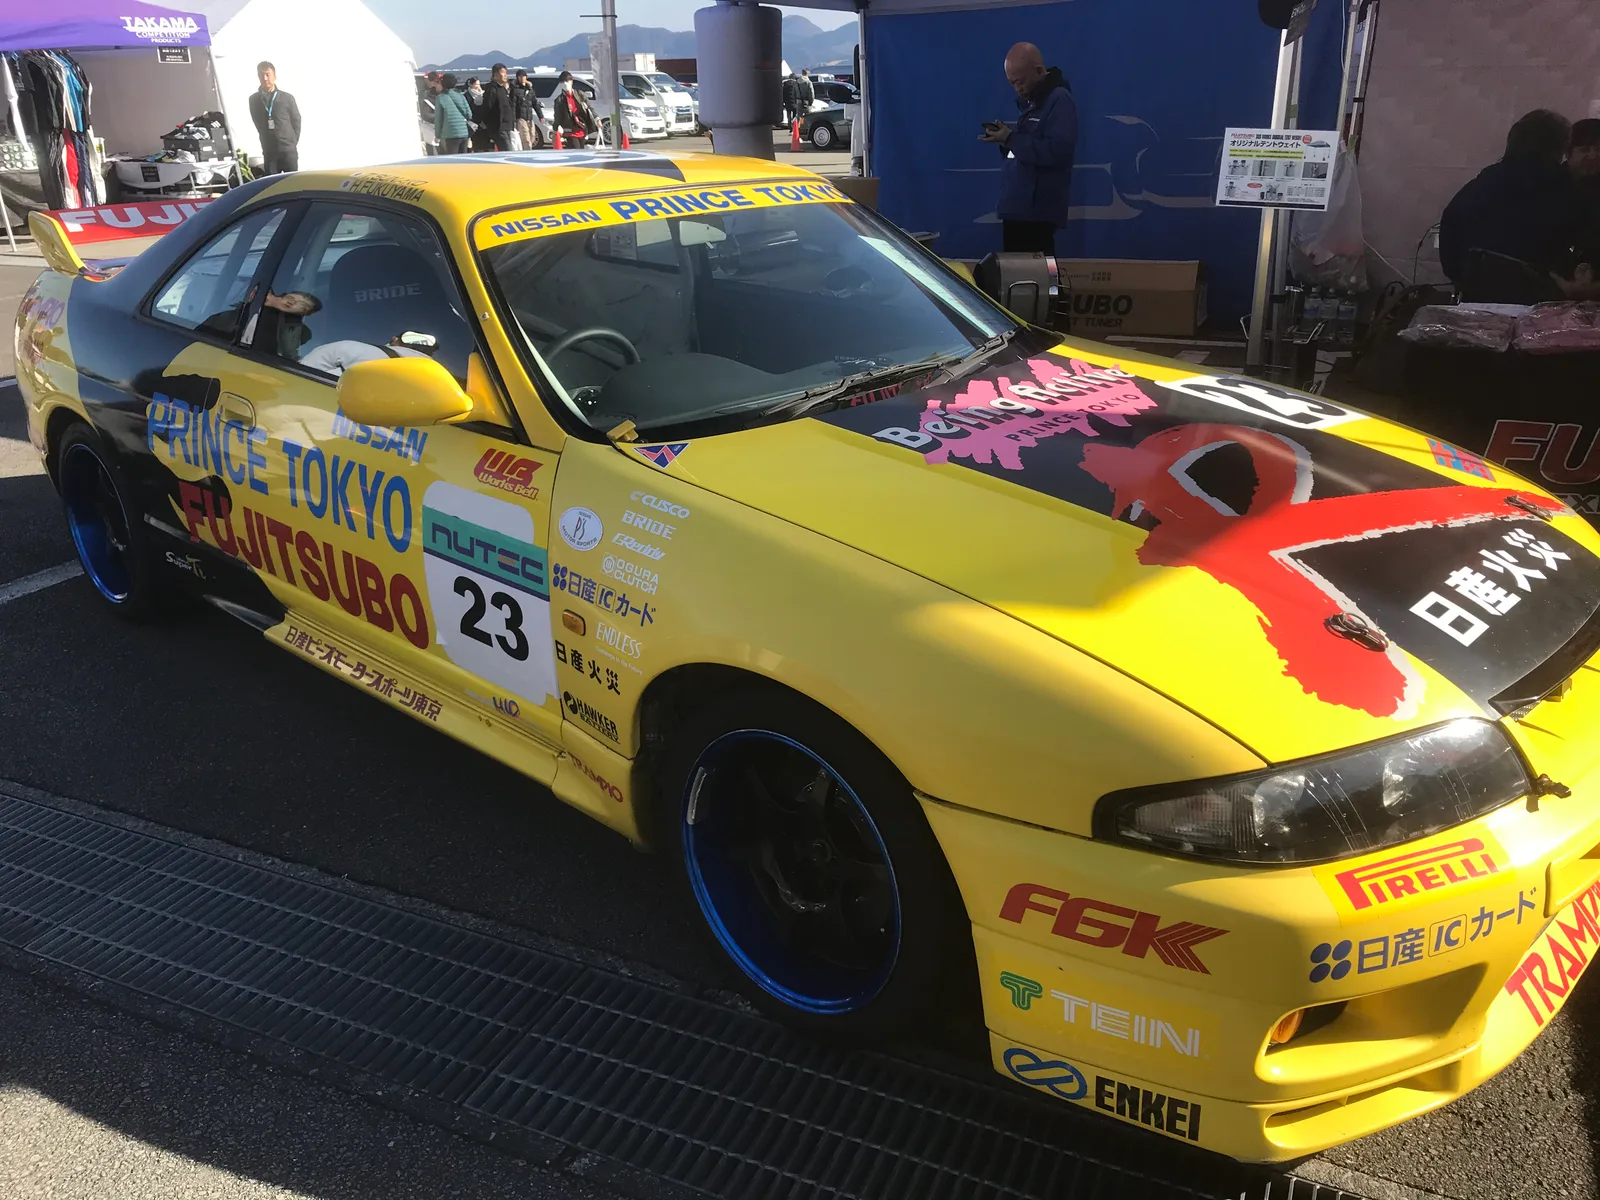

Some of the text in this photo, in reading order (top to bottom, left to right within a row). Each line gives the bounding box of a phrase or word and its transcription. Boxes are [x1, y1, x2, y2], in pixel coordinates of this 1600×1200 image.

[120, 16, 198, 29] TAKAMA
[348, 179, 425, 202] H.FUKUYAMA
[491, 184, 849, 237] NISSAN PRINCE TOKYO
[59, 202, 213, 233] FUJI
[354, 283, 422, 302] BRIDE
[871, 397, 1037, 450] Being
[1005, 393, 1141, 442] PRINCE TOKYO
[1180, 380, 1348, 425] 23
[332, 408, 428, 463] NISSAN
[148, 392, 413, 553] PRINCE TOKYO
[479, 472, 539, 500] Works Bell
[622, 510, 676, 540] BRIDE
[641, 495, 690, 519] CUSCO
[178, 481, 429, 650] FUJITSUBO
[432, 522, 544, 586] NUTEC
[612, 532, 665, 561] GReddy
[616, 559, 659, 584] OGURA
[613, 571, 657, 595] CLUTCH
[1408, 528, 1571, 647] 日産火災
[453, 576, 530, 662] 23
[596, 621, 642, 659] ENDLESS
[284, 625, 443, 722] 日産ピーズモータースポーツ東京
[555, 639, 621, 696] 日産火災
[577, 699, 619, 736] HAWKER
[1335, 837, 1499, 911] PIRELLI
[998, 883, 1231, 976] FGK
[1050, 988, 1201, 1058] TEIN
[1095, 1075, 1201, 1142] ENKEI
